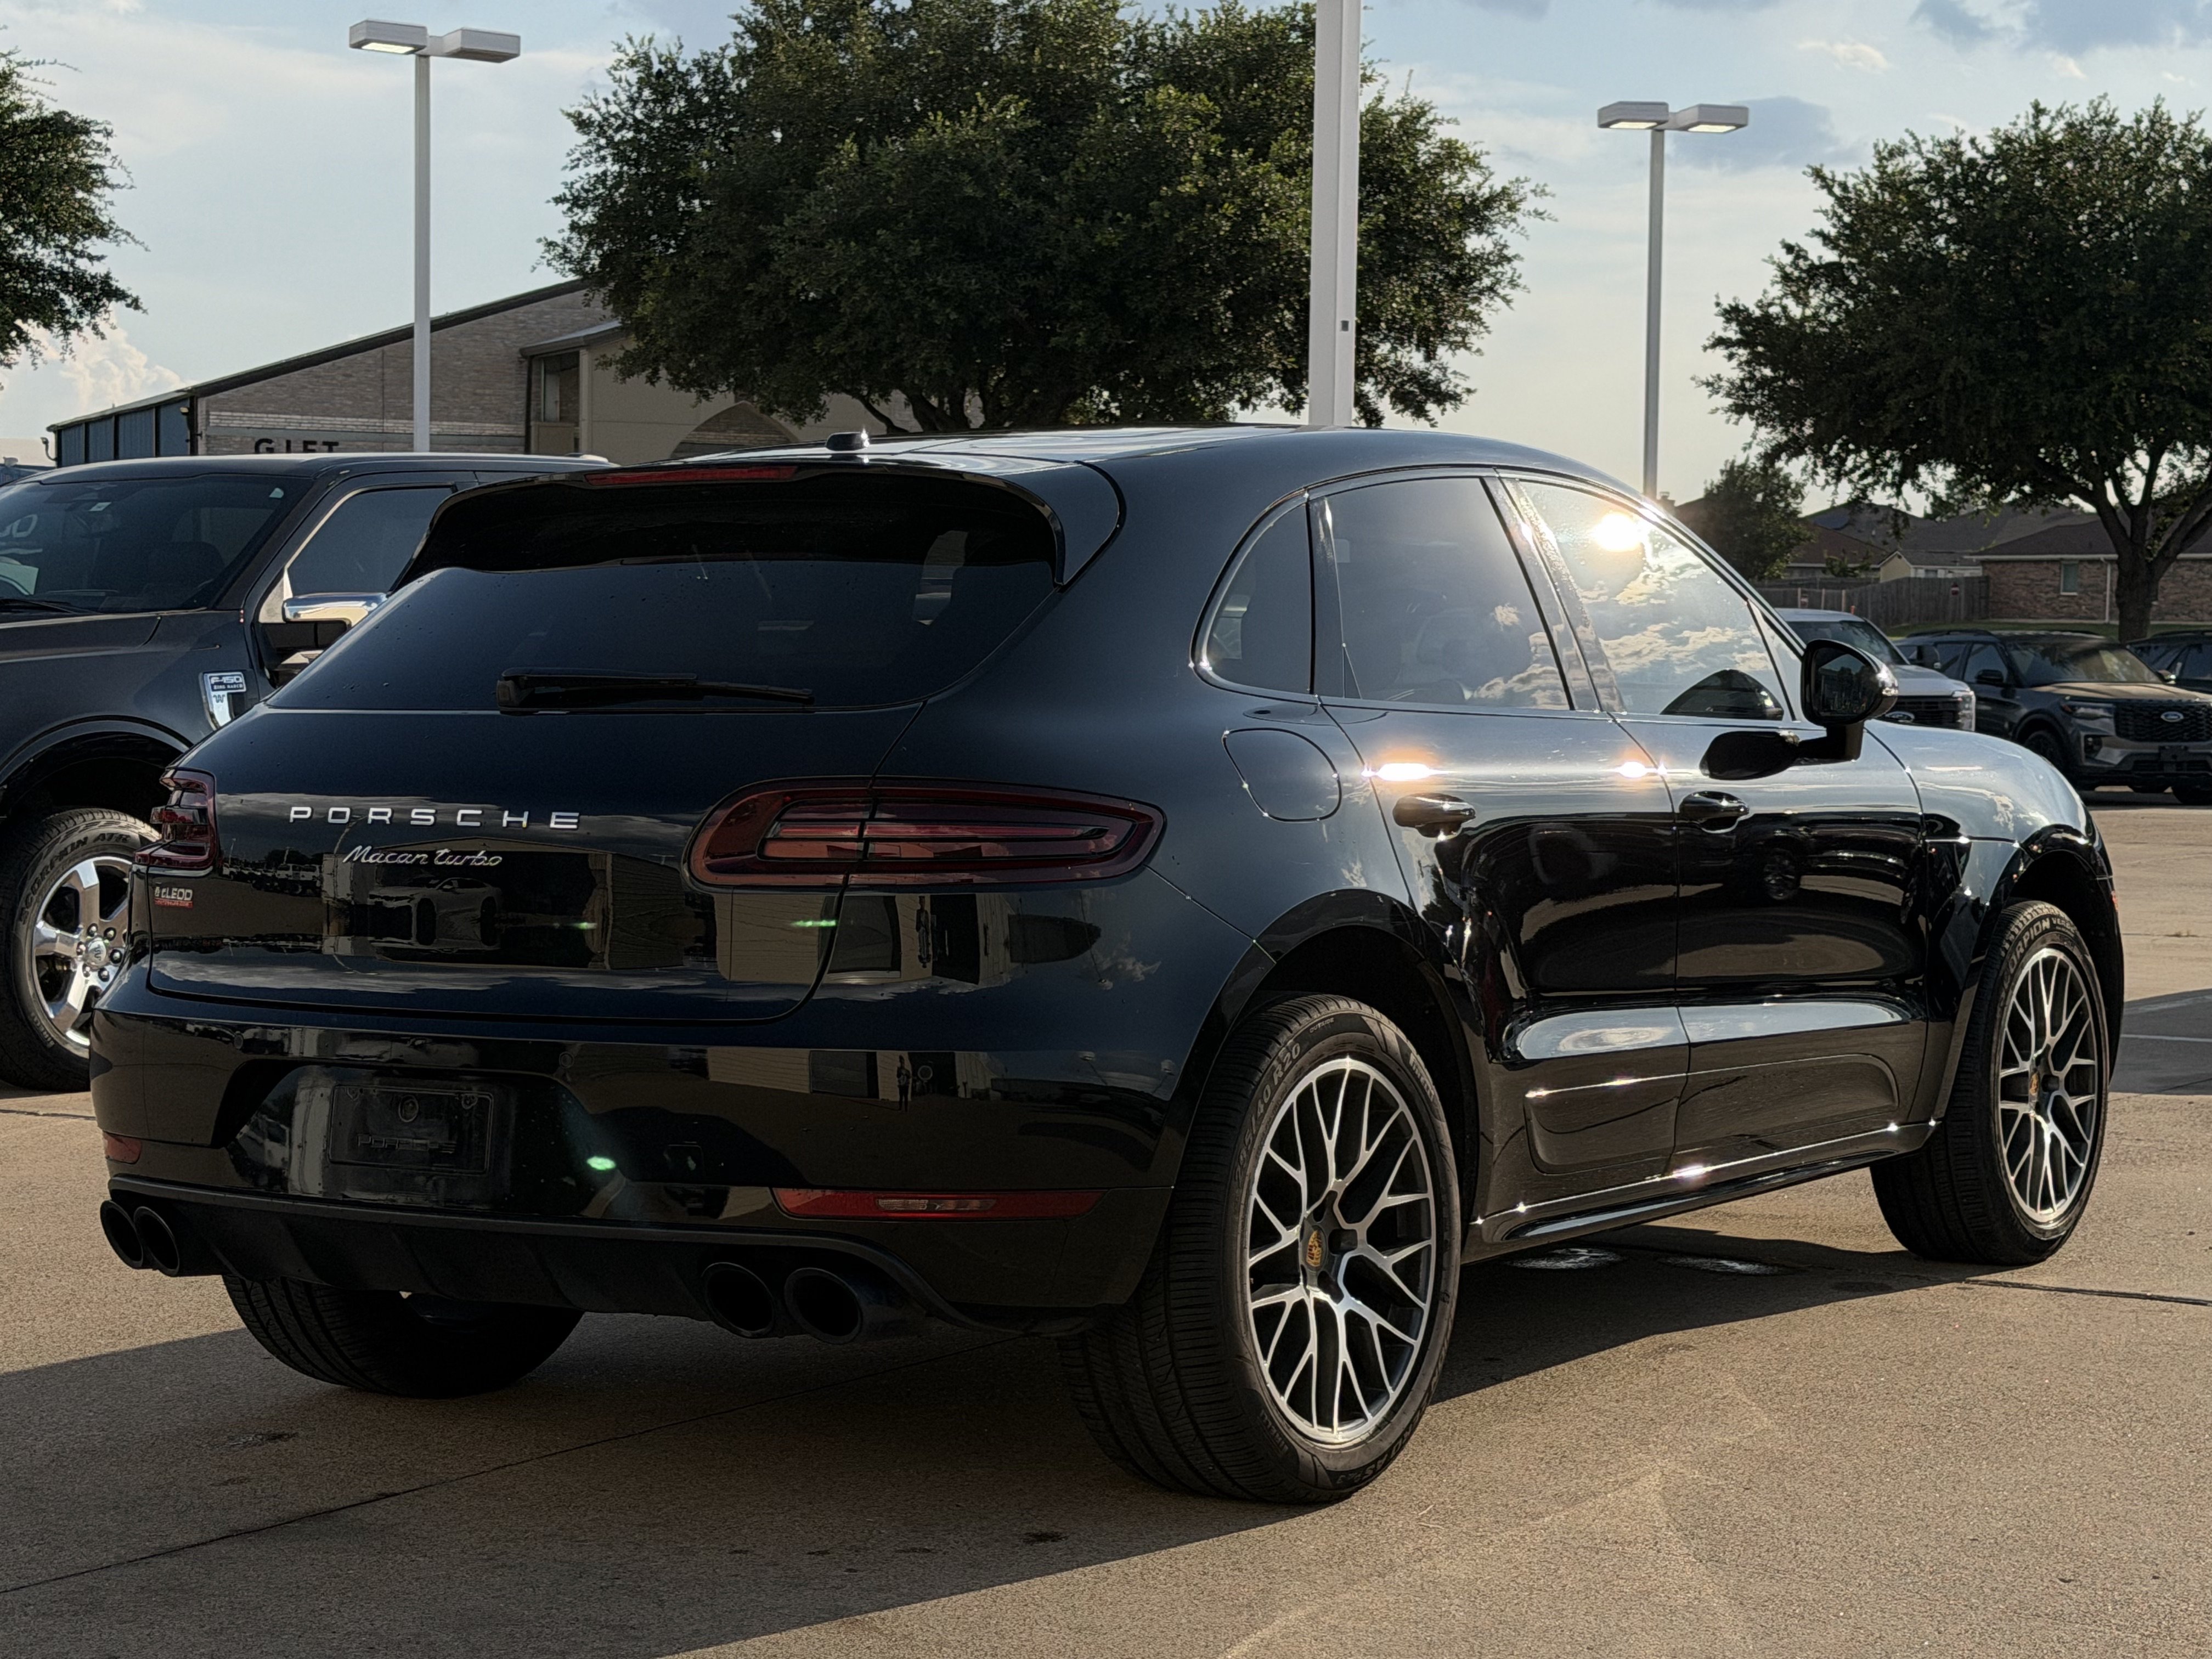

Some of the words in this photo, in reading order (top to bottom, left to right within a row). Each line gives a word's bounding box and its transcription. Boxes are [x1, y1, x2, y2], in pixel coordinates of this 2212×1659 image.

[255, 438, 339, 453] GIFT
[211, 676, 242, 684] F-150
[289, 806, 580, 830] PORSCHE
[342, 845, 429, 865] Macan
[433, 848, 503, 866] turbo
[1309, 1017, 1335, 1034] OUTSIDE
[1273, 1042, 1301, 1086] R20
